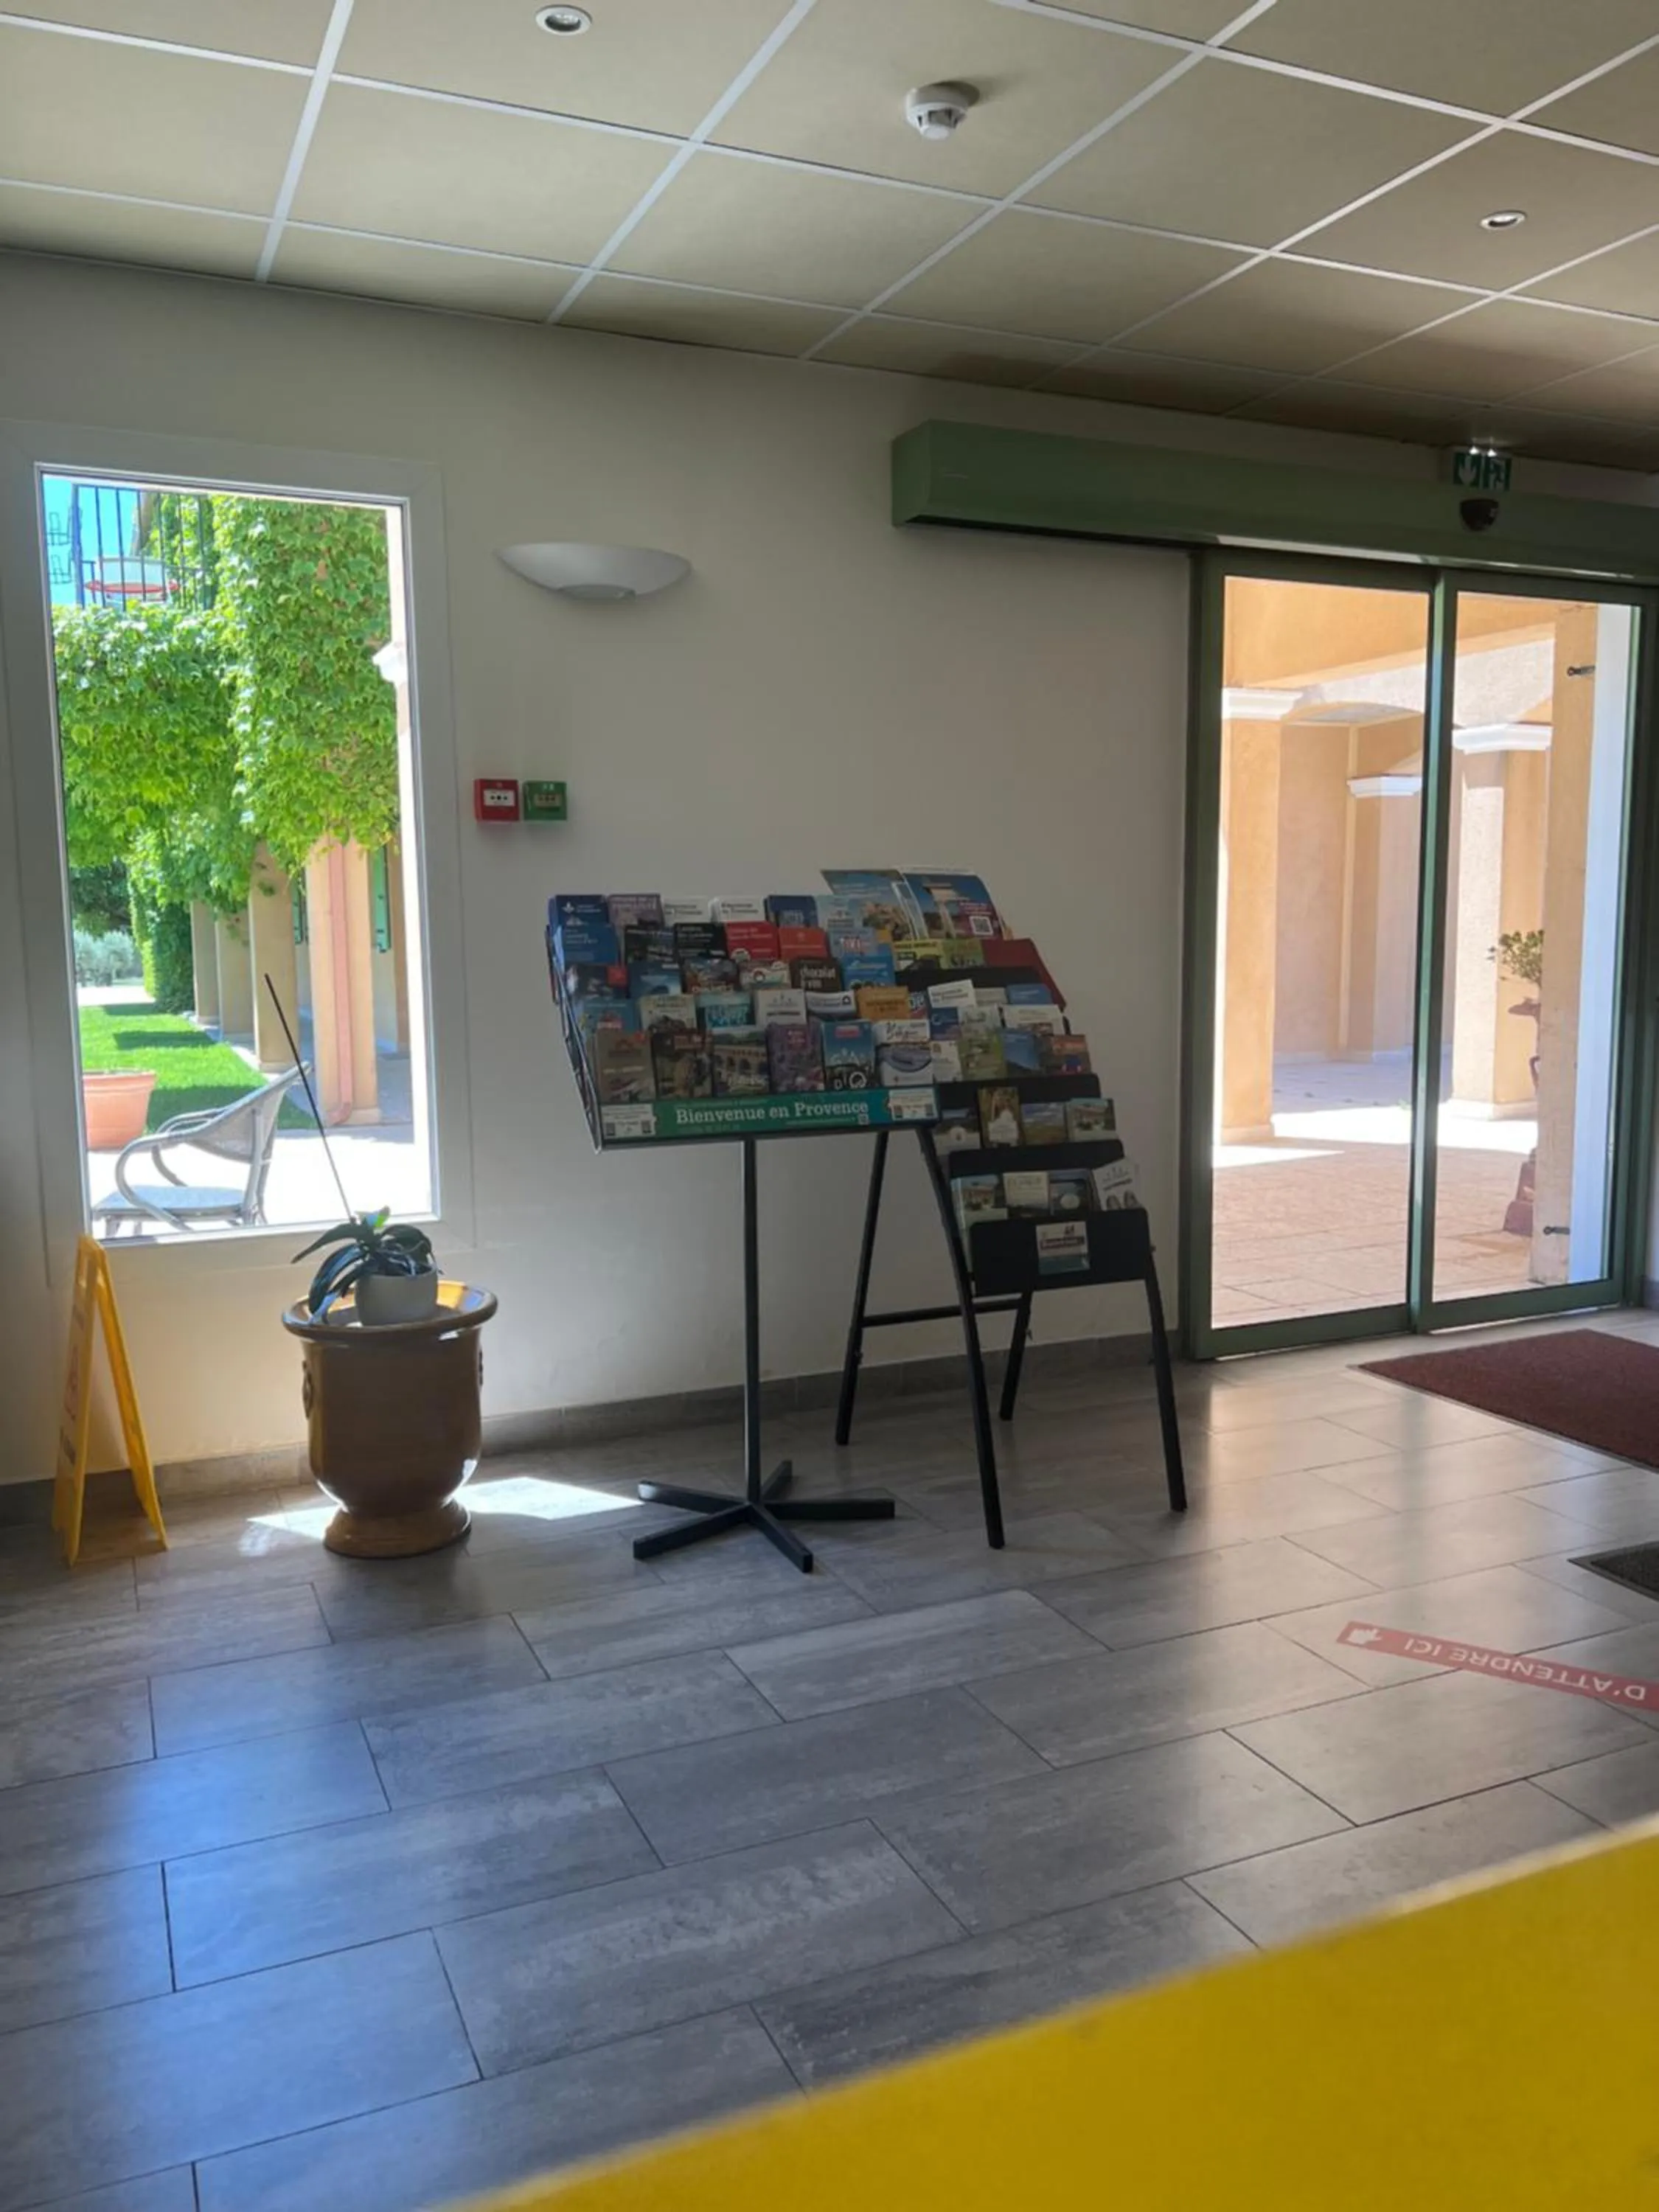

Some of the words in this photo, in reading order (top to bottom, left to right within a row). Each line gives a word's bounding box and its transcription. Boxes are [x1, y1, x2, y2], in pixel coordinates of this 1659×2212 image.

[676, 1106, 765, 1125] Bienvenue
[769, 1105, 790, 1119] en
[794, 1100, 869, 1118] Provence
[1405, 1638, 1442, 1655] ICI
[1450, 1649, 1646, 1701] D'ATTENDRE
